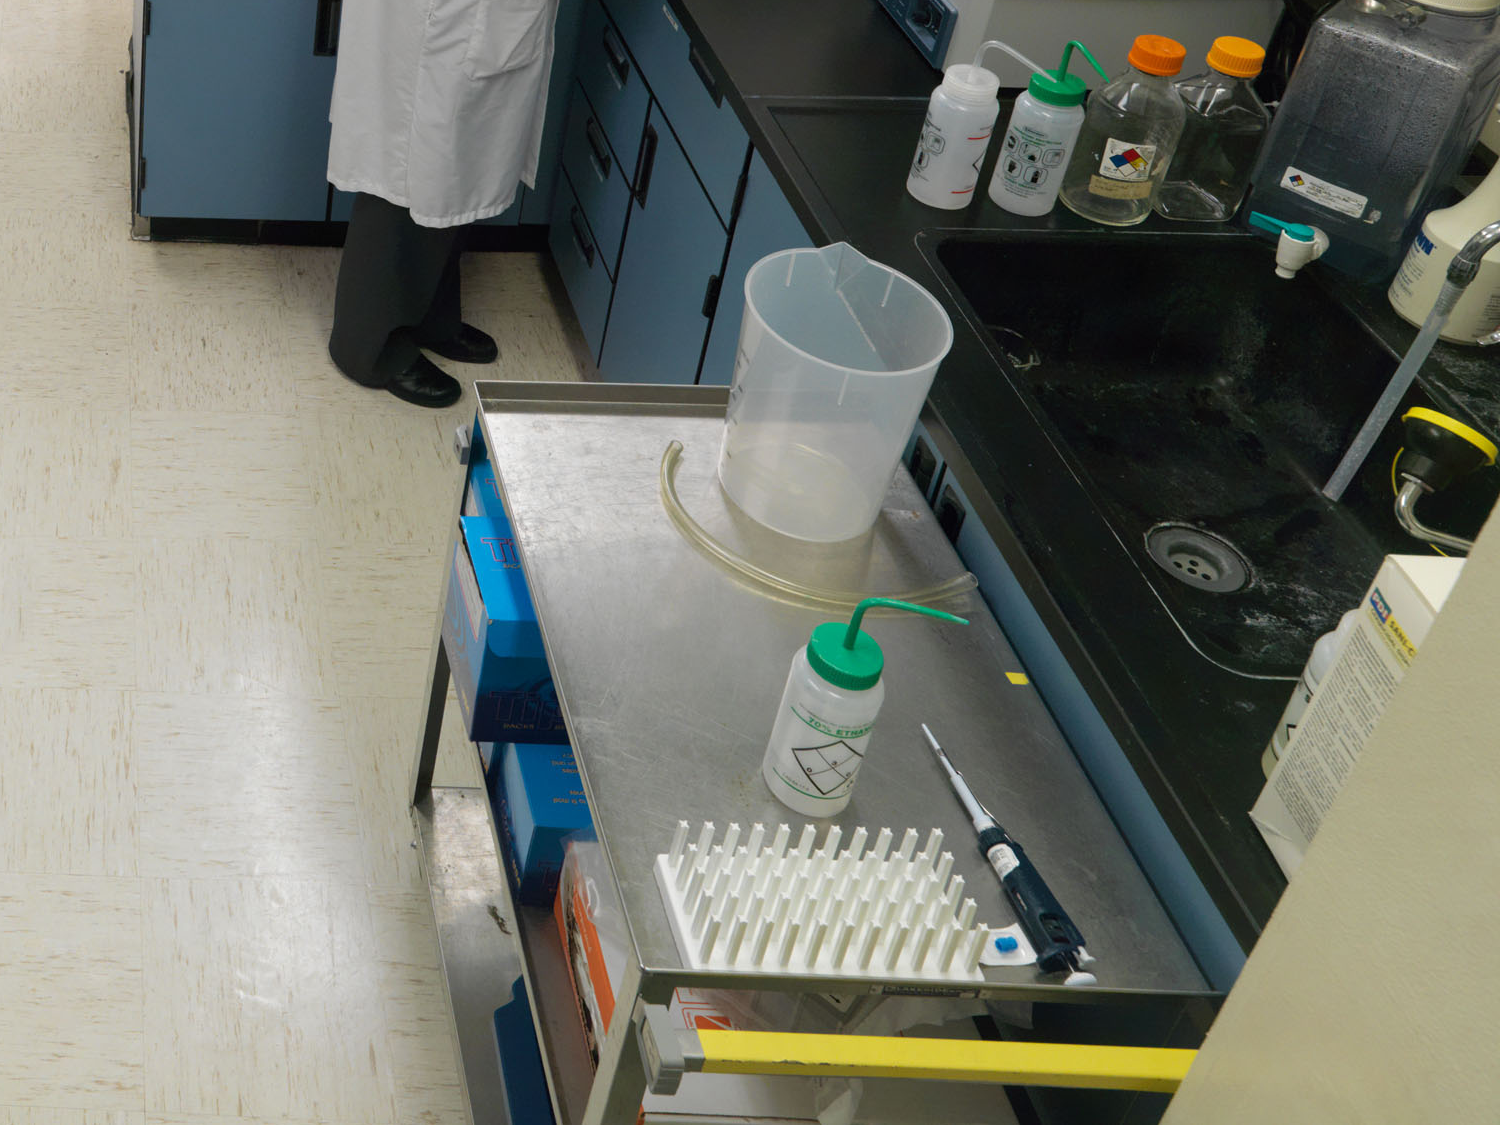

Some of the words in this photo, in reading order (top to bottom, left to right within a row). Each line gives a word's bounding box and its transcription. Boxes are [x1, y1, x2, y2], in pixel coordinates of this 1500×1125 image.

[1372, 591, 1388, 619] PDI
[1390, 619, 1414, 657] SANI-C
[808, 716, 832, 733] 70%
